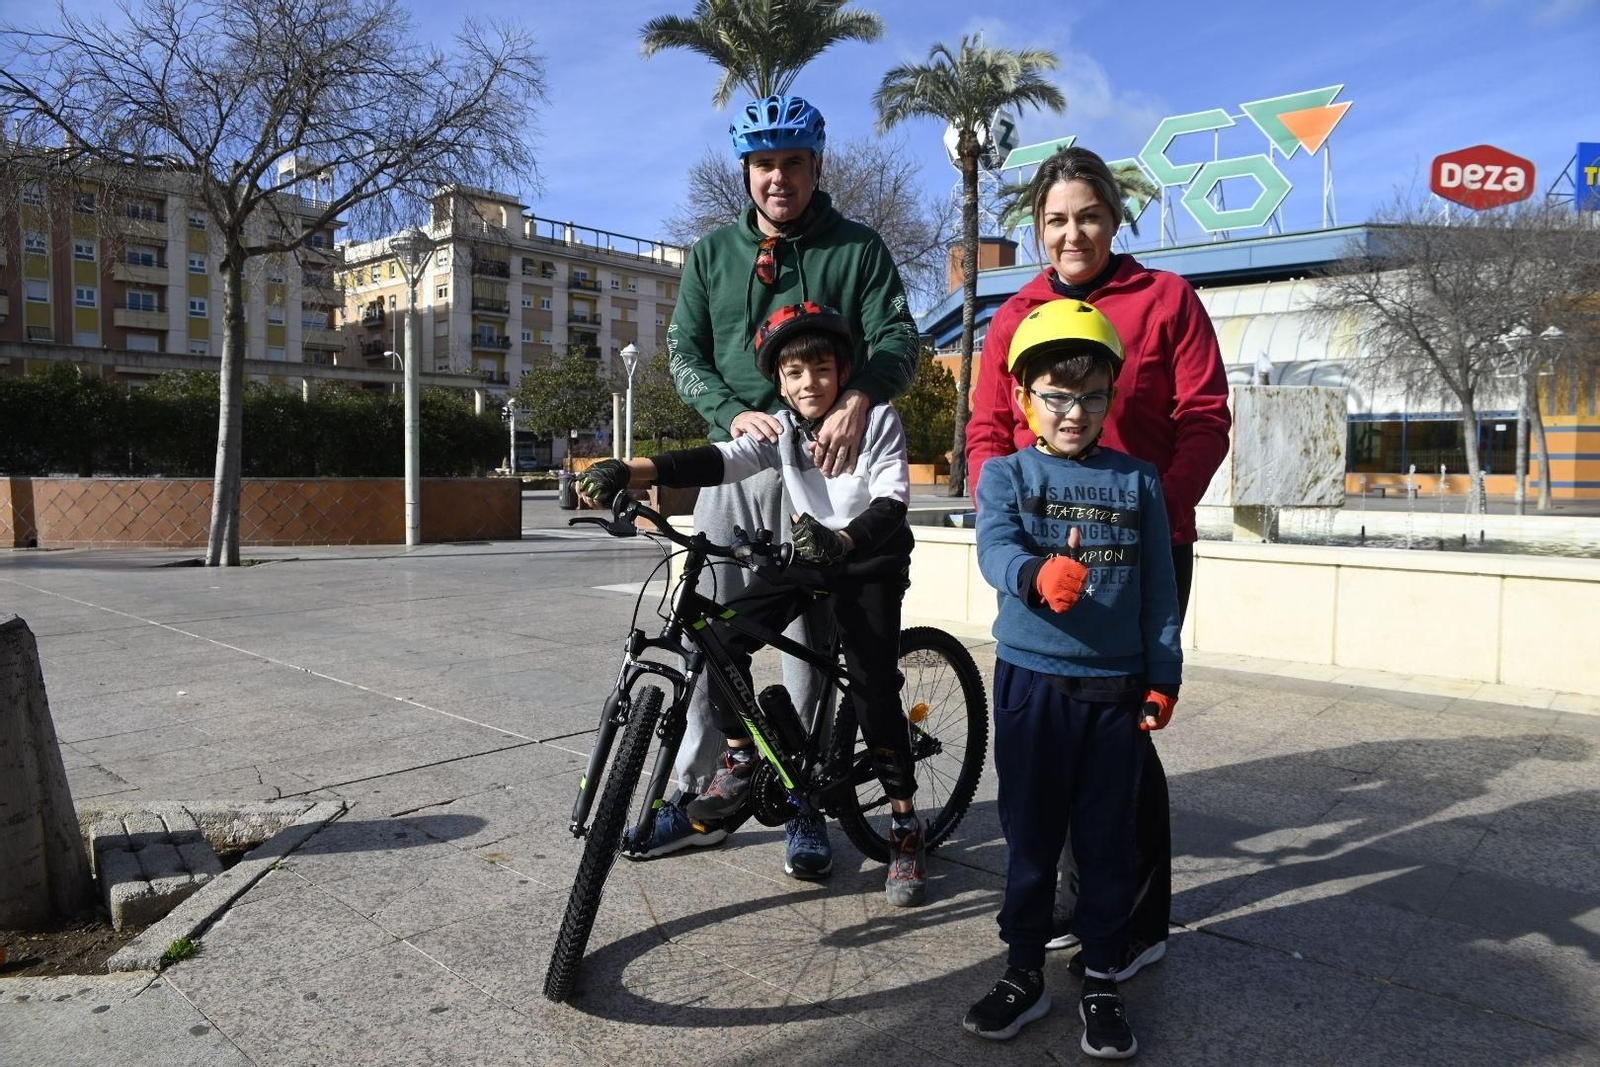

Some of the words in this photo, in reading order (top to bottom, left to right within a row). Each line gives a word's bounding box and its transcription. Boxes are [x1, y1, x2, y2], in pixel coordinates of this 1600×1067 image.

[999, 119, 1015, 149] Z
[1584, 166, 1600, 186] T
[1063, 485, 1137, 503] ANGELES
[1045, 504, 1121, 523] STATESIDE
[1031, 521, 1060, 539] LOS
[1045, 548, 1124, 563] MPION
